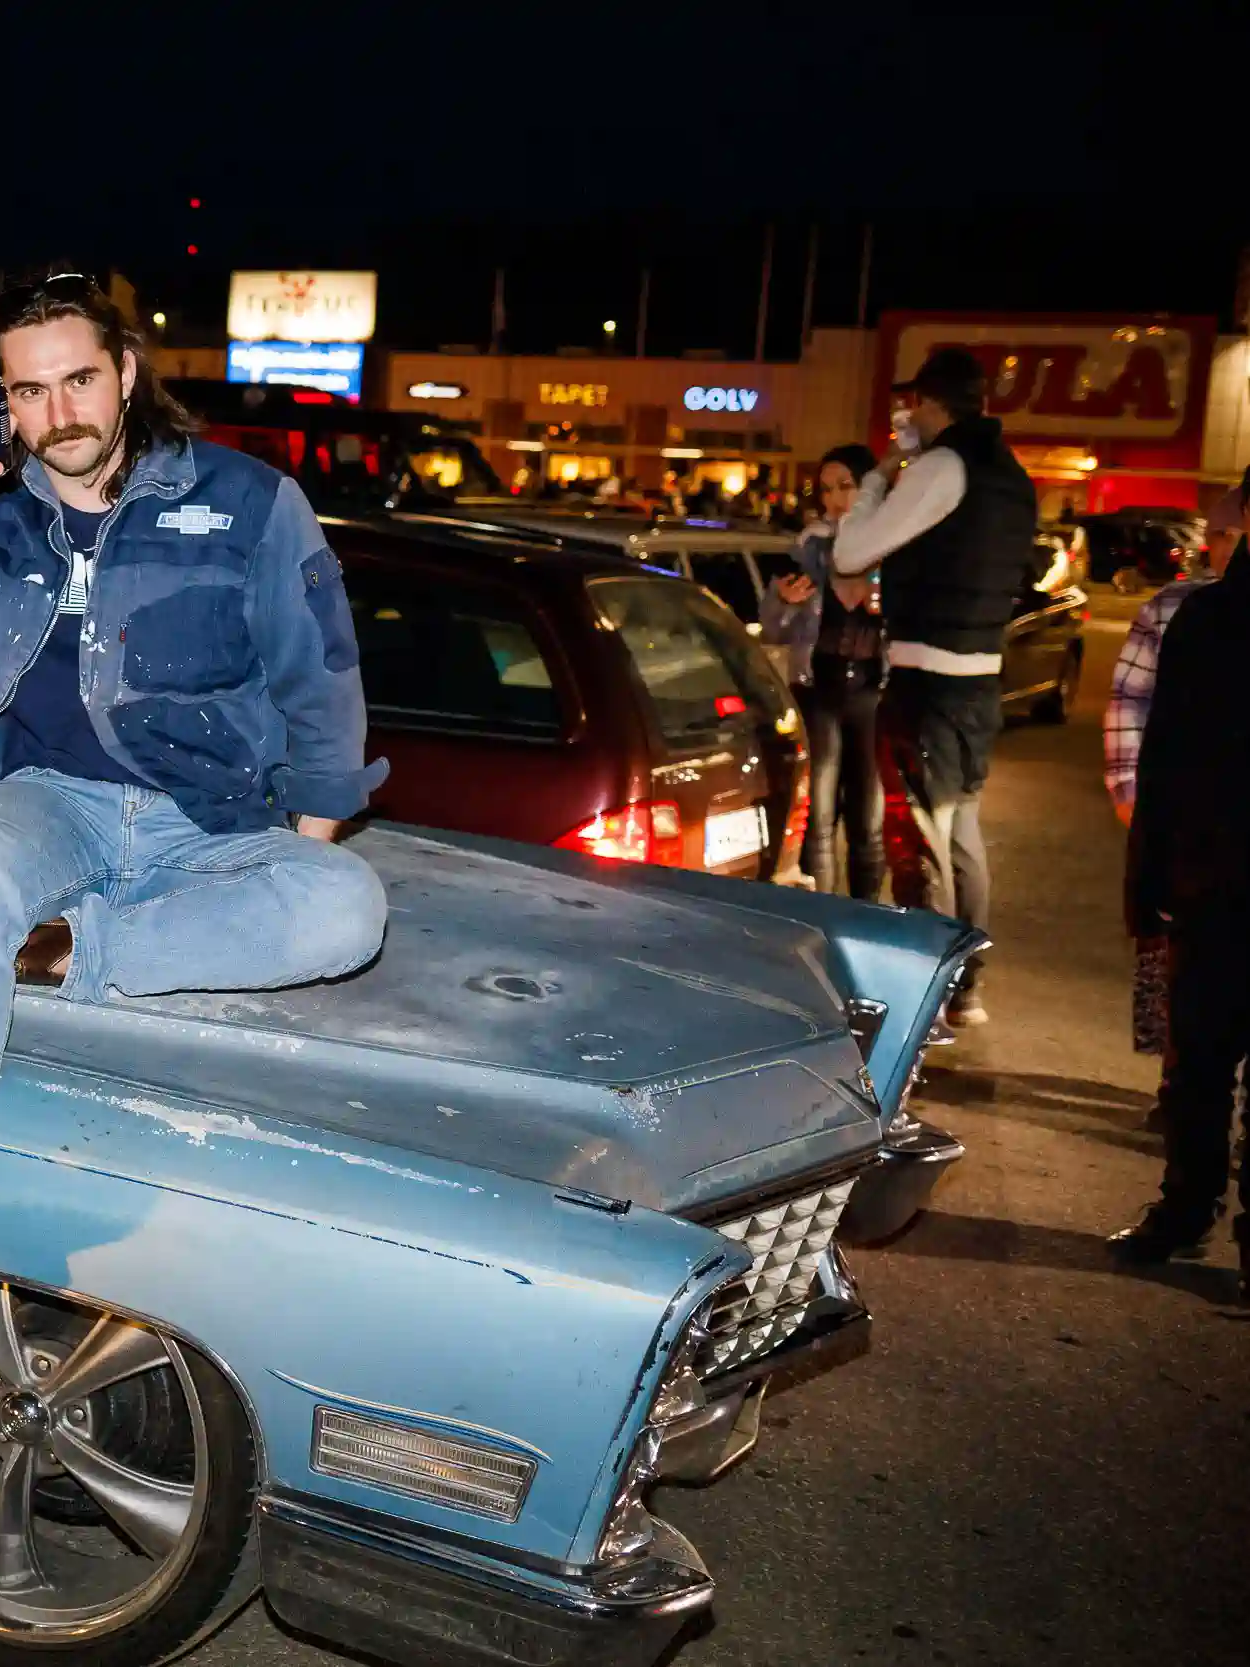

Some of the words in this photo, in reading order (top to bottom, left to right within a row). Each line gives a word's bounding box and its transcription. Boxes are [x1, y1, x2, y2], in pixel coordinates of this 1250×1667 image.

[930, 342, 1176, 419] ULA
[539, 383, 609, 407] TAPET
[684, 387, 758, 411] GOLV
